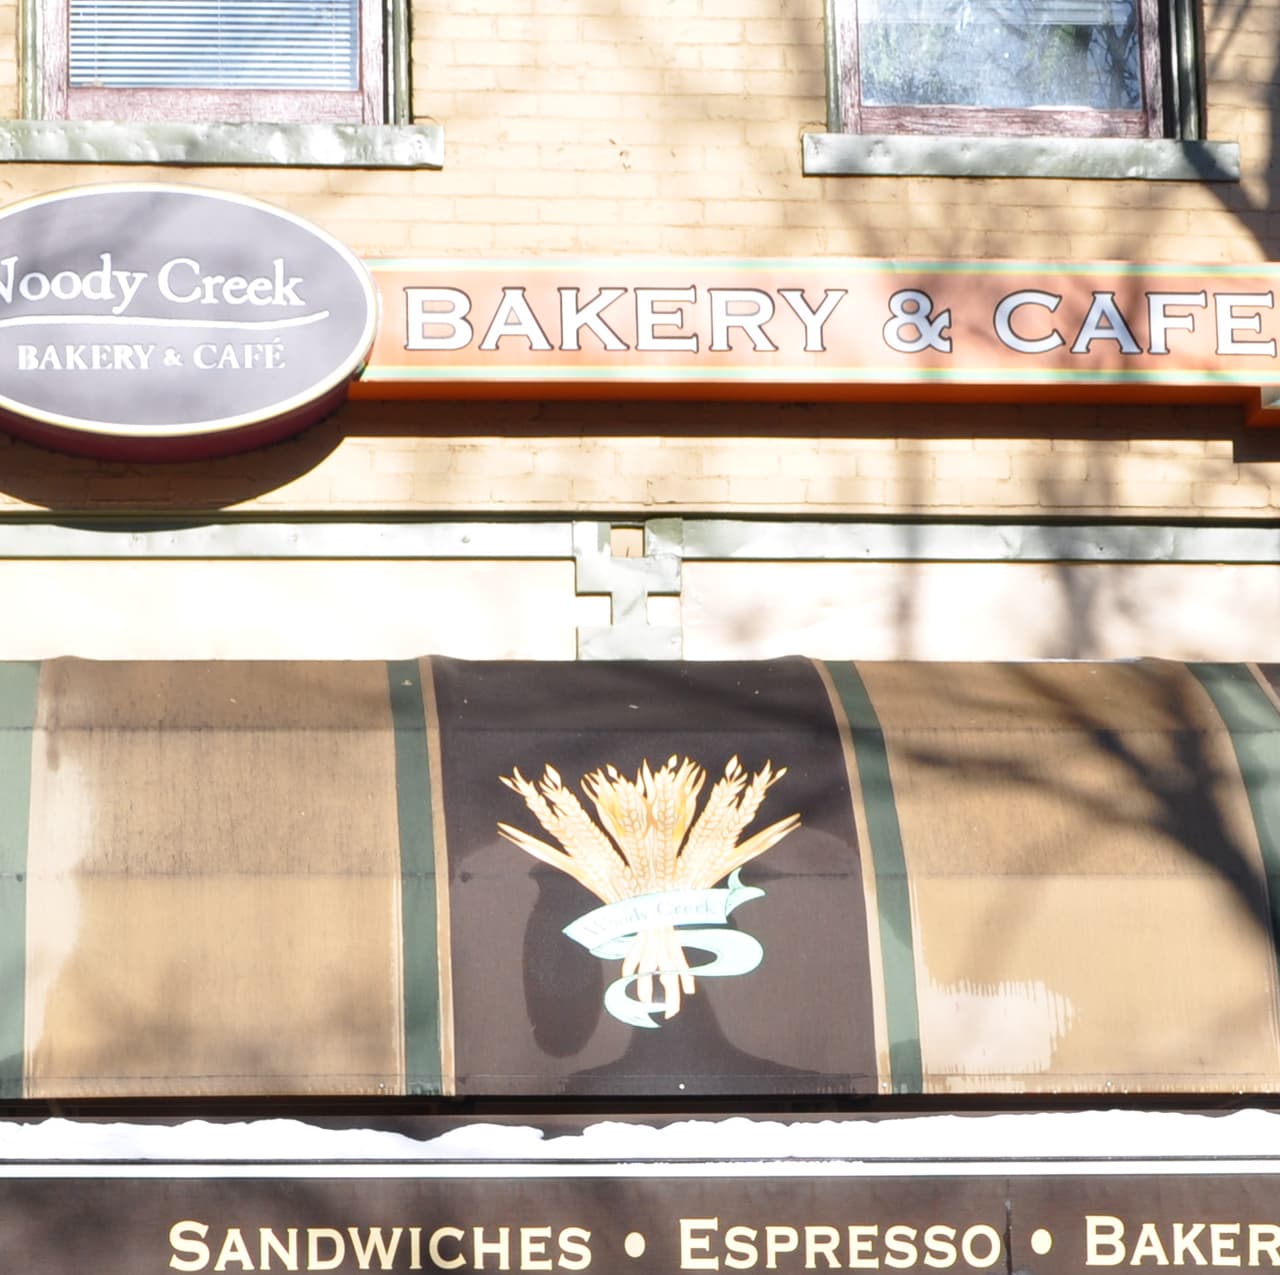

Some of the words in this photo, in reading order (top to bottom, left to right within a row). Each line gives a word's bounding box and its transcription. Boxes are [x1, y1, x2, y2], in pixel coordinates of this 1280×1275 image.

[158, 257, 307, 307] Creek
[402, 286, 849, 353] BAKERY
[882, 286, 954, 354] &
[992, 288, 1279, 358] CAFE
[16, 342, 156, 371] BAKERY
[163, 348, 183, 369] &
[192, 336, 286, 371] CAFÉ
